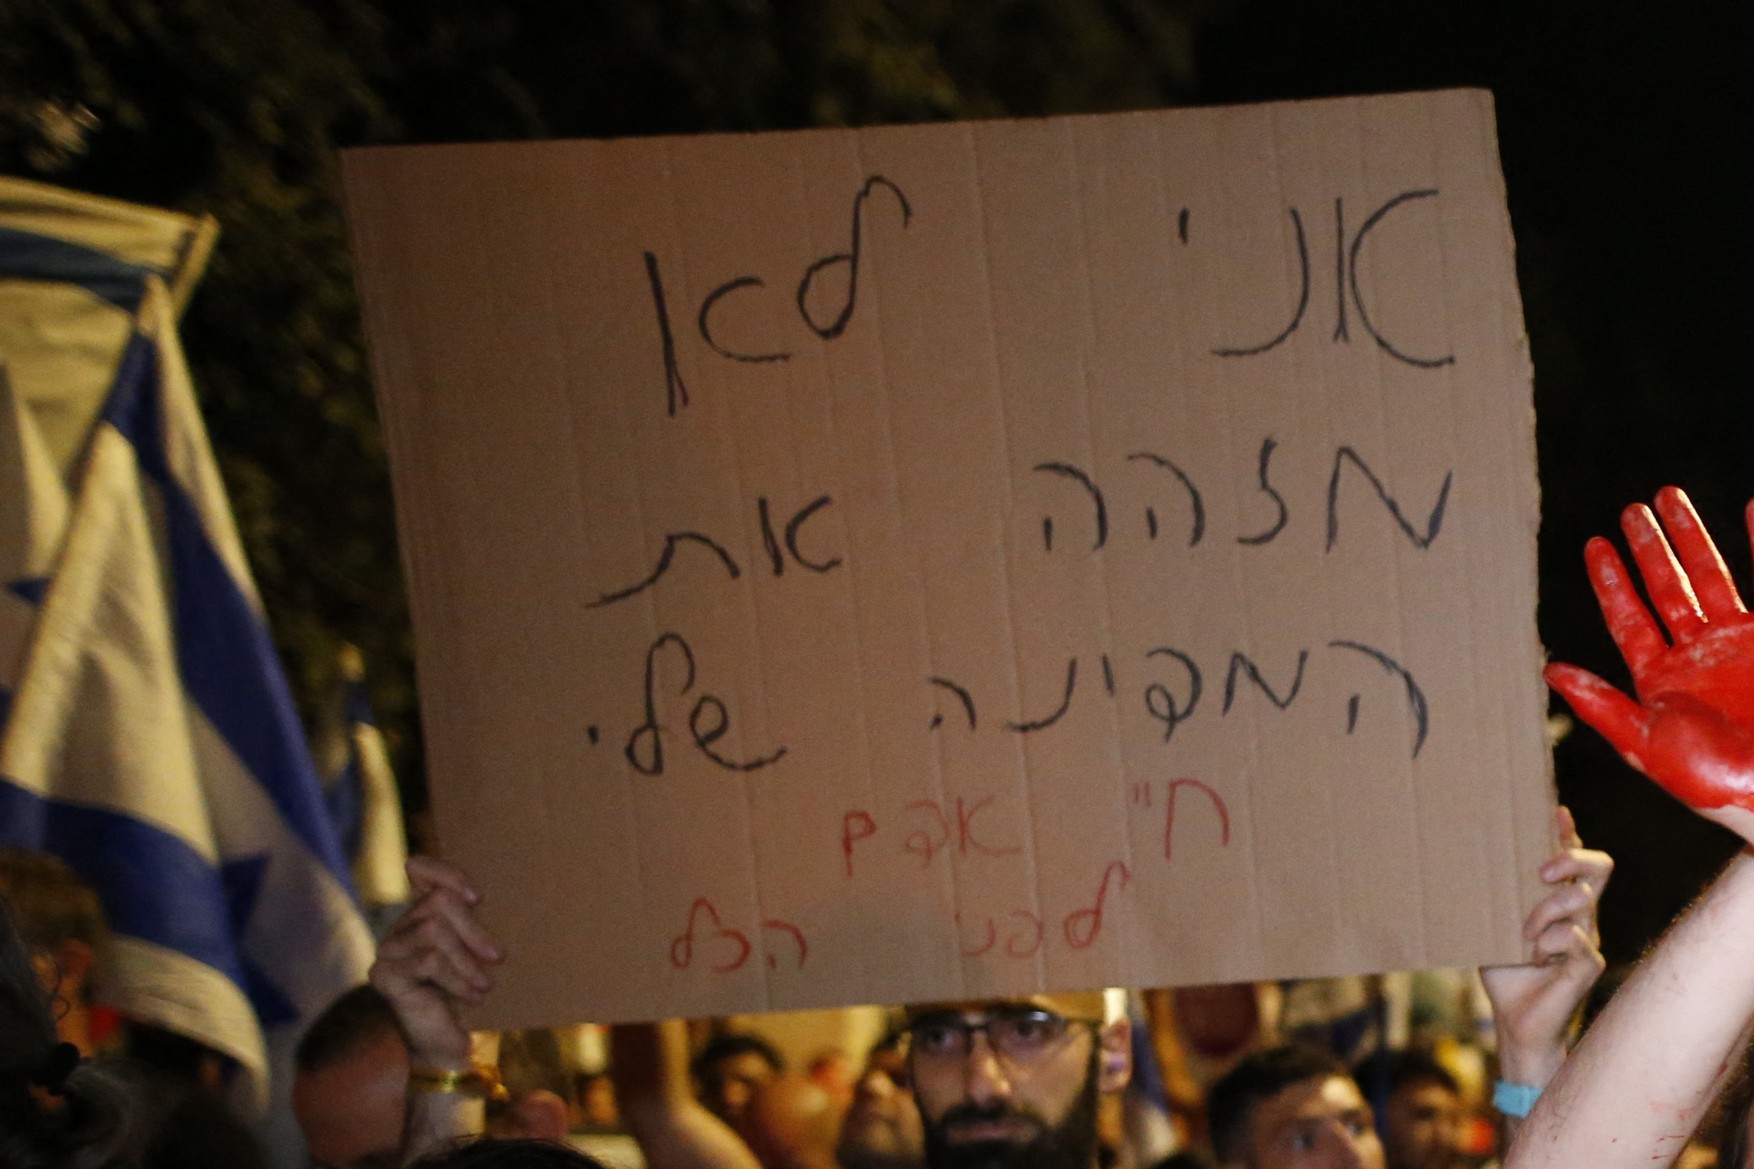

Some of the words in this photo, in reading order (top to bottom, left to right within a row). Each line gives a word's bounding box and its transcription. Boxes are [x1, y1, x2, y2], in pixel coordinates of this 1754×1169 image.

[642, 173, 914, 418] לא
[1177, 187, 1458, 371] אני
[584, 494, 843, 609] את
[1031, 435, 1454, 555] מזהה
[585, 631, 789, 777] שלי
[927, 638, 1430, 761] המדינה
[670, 895, 810, 973] הכל
[952, 860, 1133, 959] לפני
